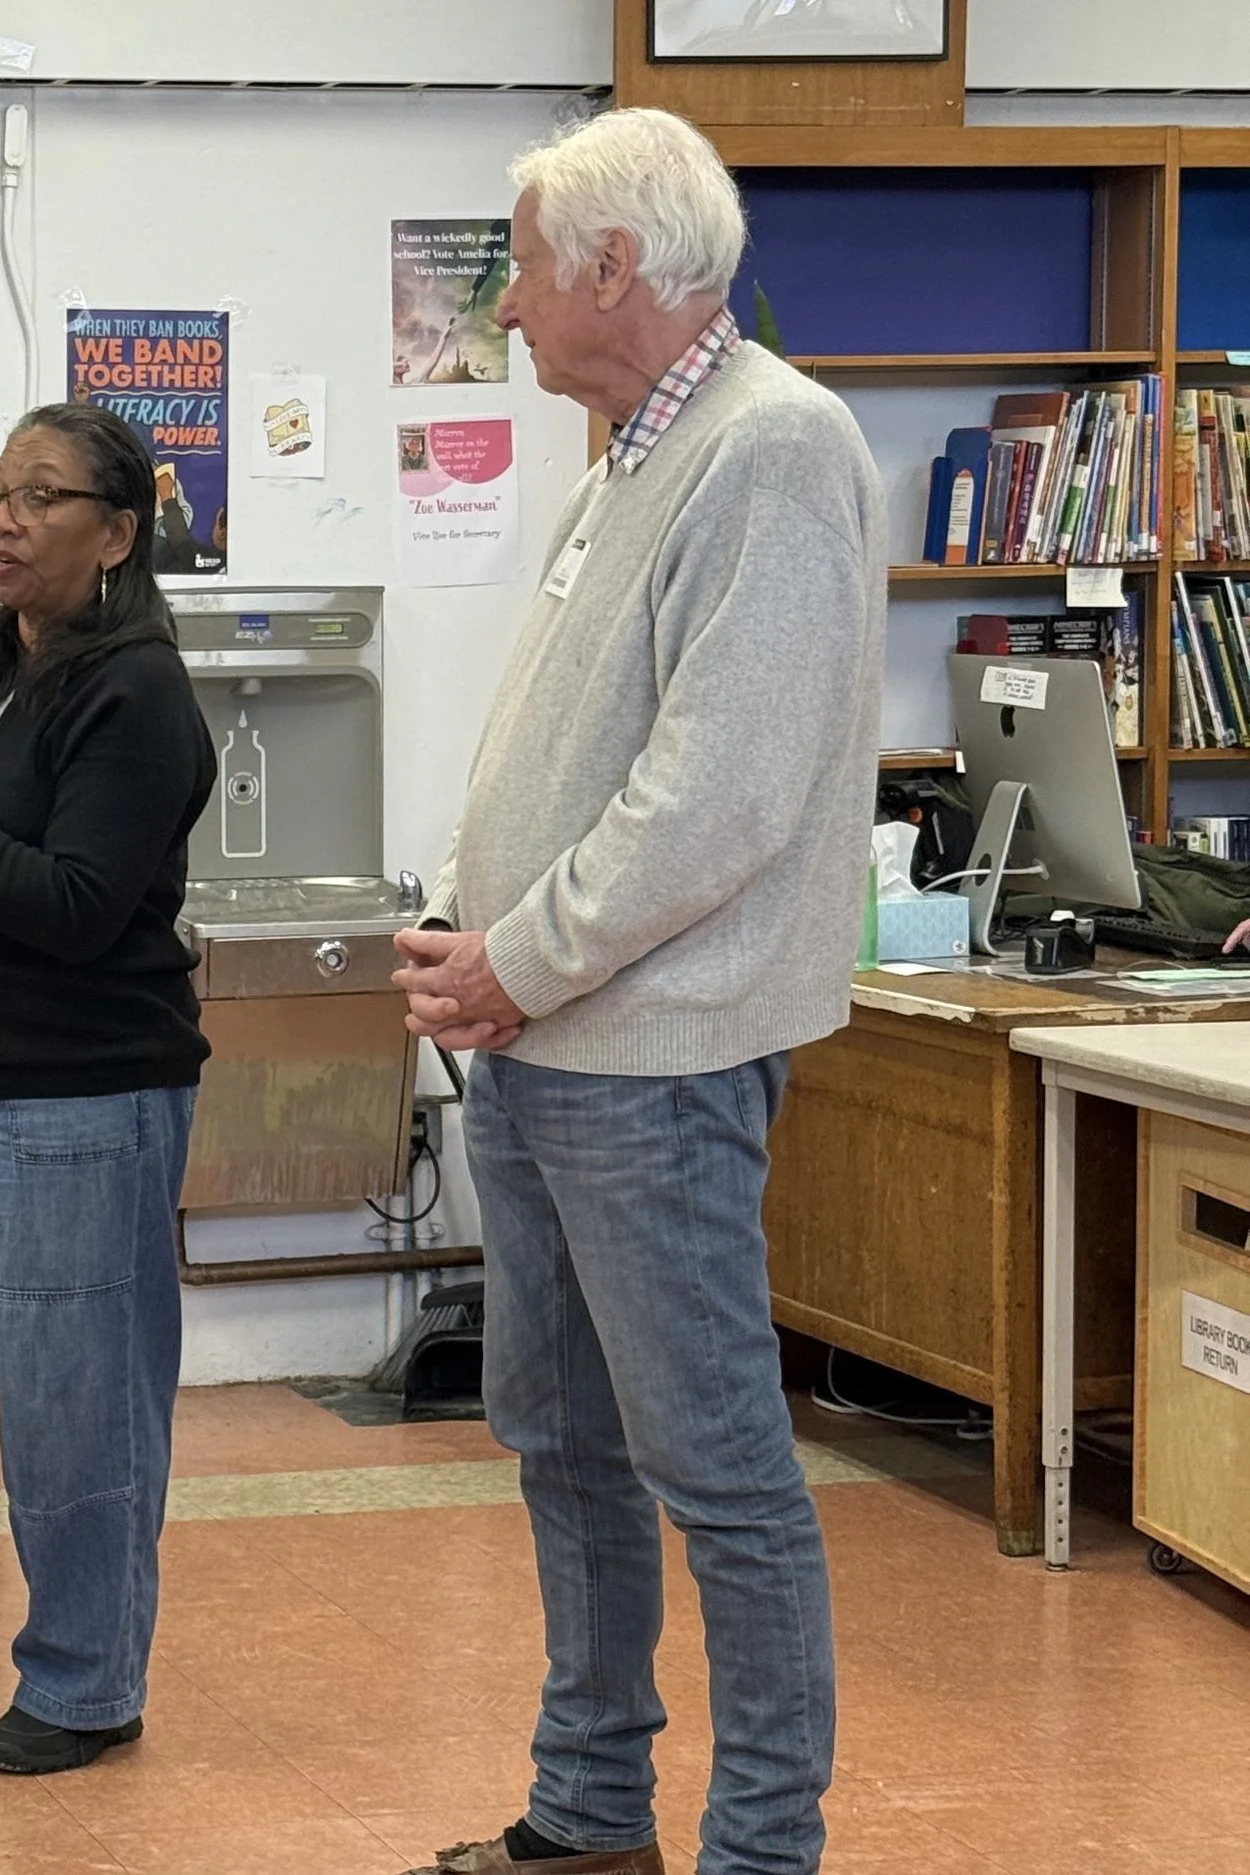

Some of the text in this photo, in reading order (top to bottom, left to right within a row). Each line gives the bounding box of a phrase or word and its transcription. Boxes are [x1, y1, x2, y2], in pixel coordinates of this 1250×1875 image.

[397, 232, 422, 243] Want
[432, 232, 477, 245] wickedly
[479, 232, 505, 245] good
[393, 248, 509, 259] school? Vote Amelia for
[414, 265, 487, 276] Vice President!
[75, 318, 223, 340] WHEN THEY BAN BOOKS,
[74, 338, 223, 364] WE BAND
[74, 364, 223, 388] TOGETHER!
[197, 400, 221, 426] IS
[153, 427, 221, 446] POWER.
[1122, 596, 1131, 645] OYMPIANS
[1190, 1315, 1226, 1344] LIBRARY
[1203, 1345, 1238, 1376] RETURN
